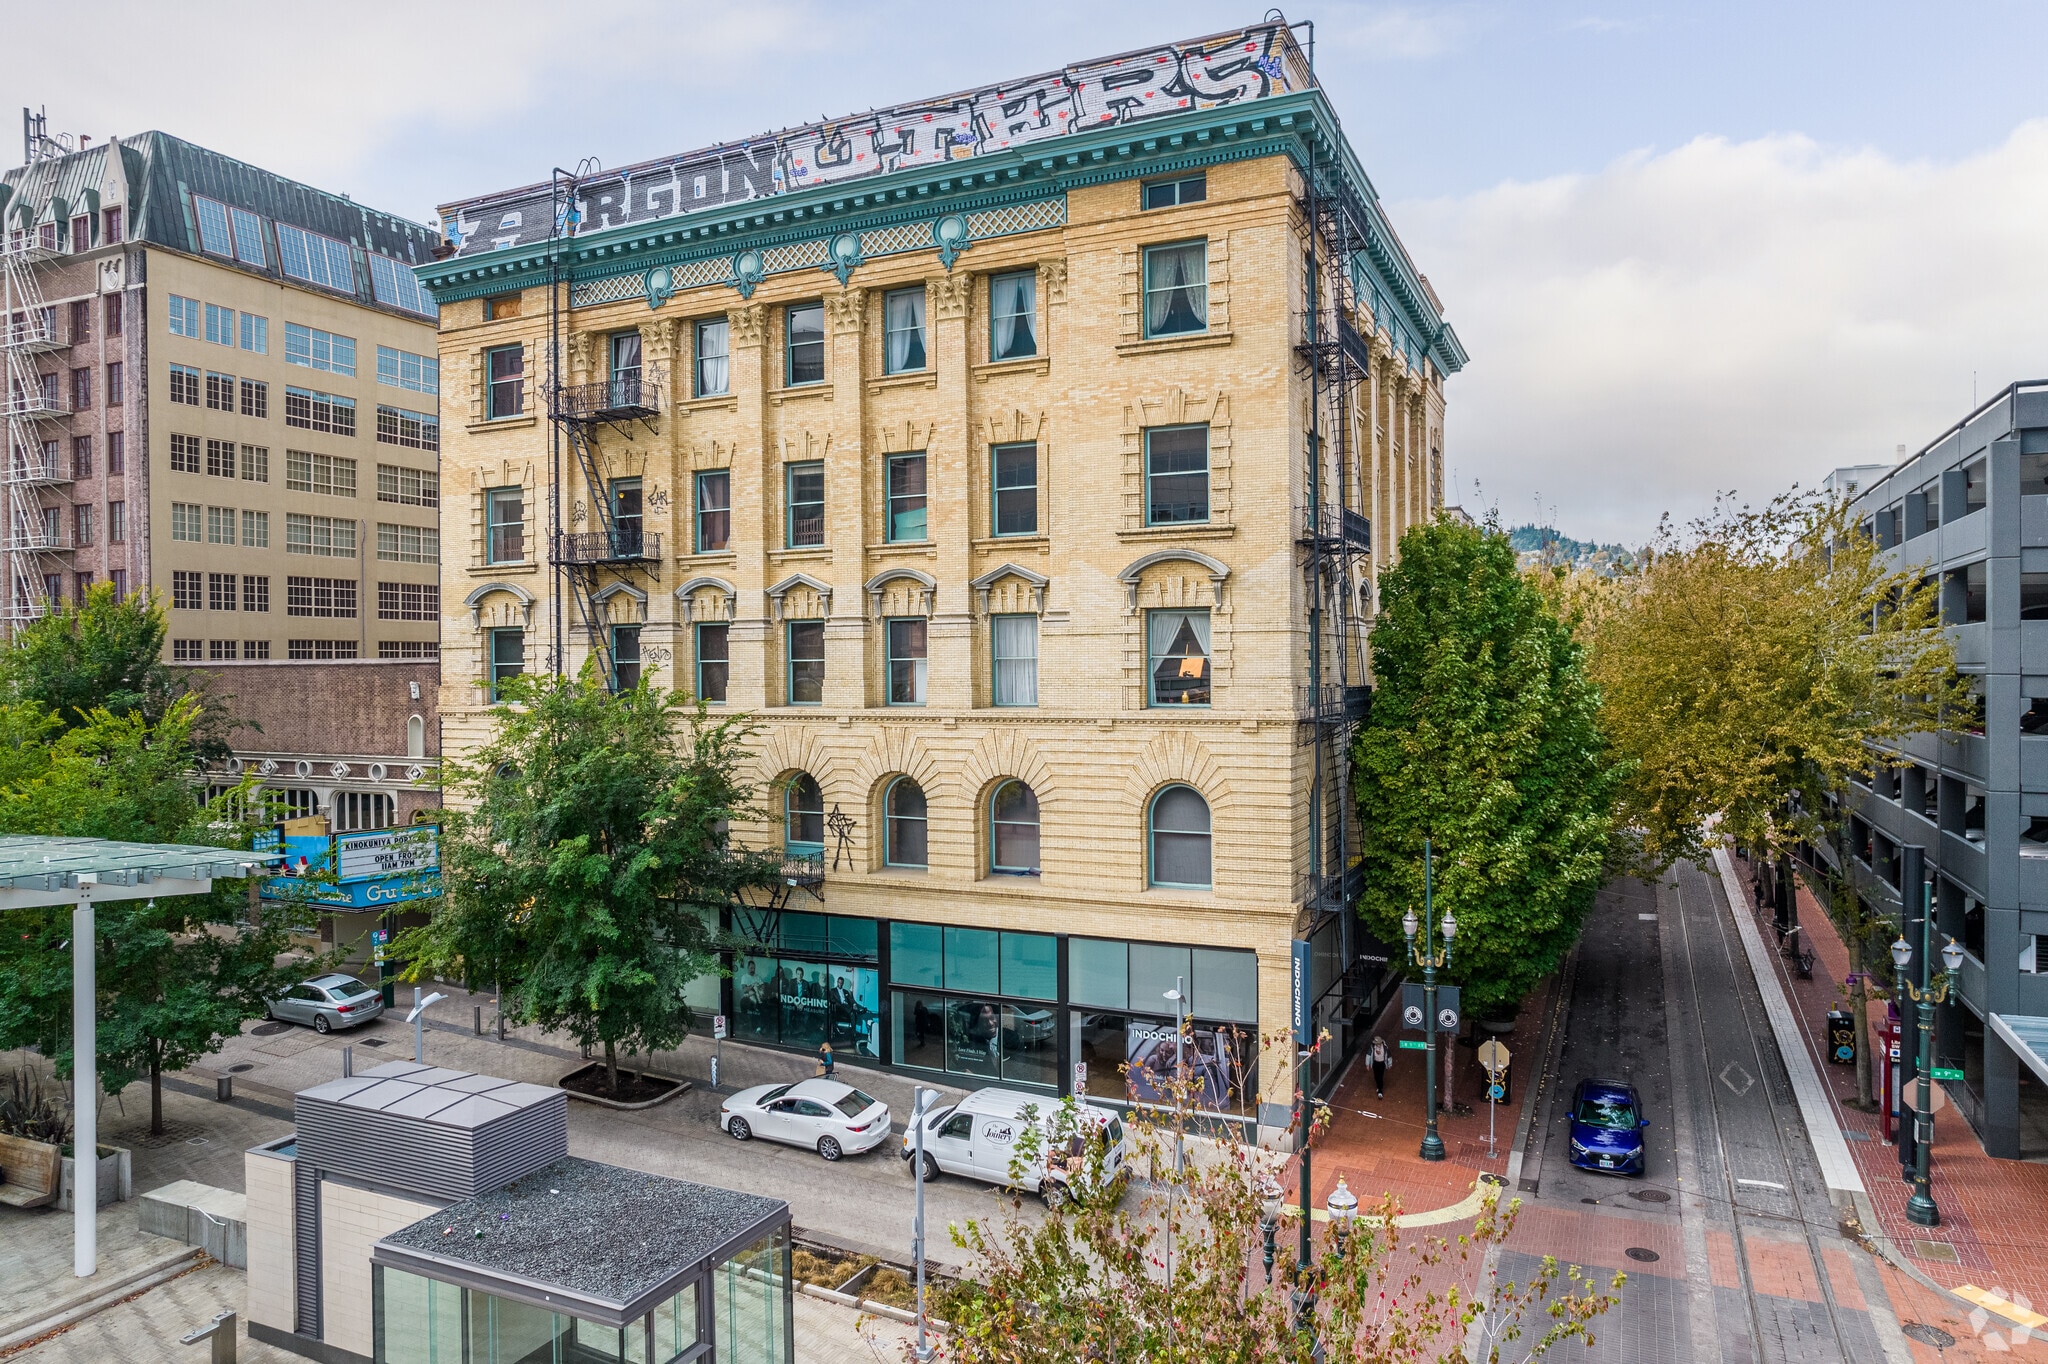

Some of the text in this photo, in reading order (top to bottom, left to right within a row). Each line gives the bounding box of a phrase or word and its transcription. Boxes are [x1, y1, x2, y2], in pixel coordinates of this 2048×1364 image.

[345, 838, 391, 850] KINOKUNIYA
[374, 853, 394, 863] OPEN
[400, 860, 415, 868] 7PM
[984, 1128, 1012, 1143] Joinery
